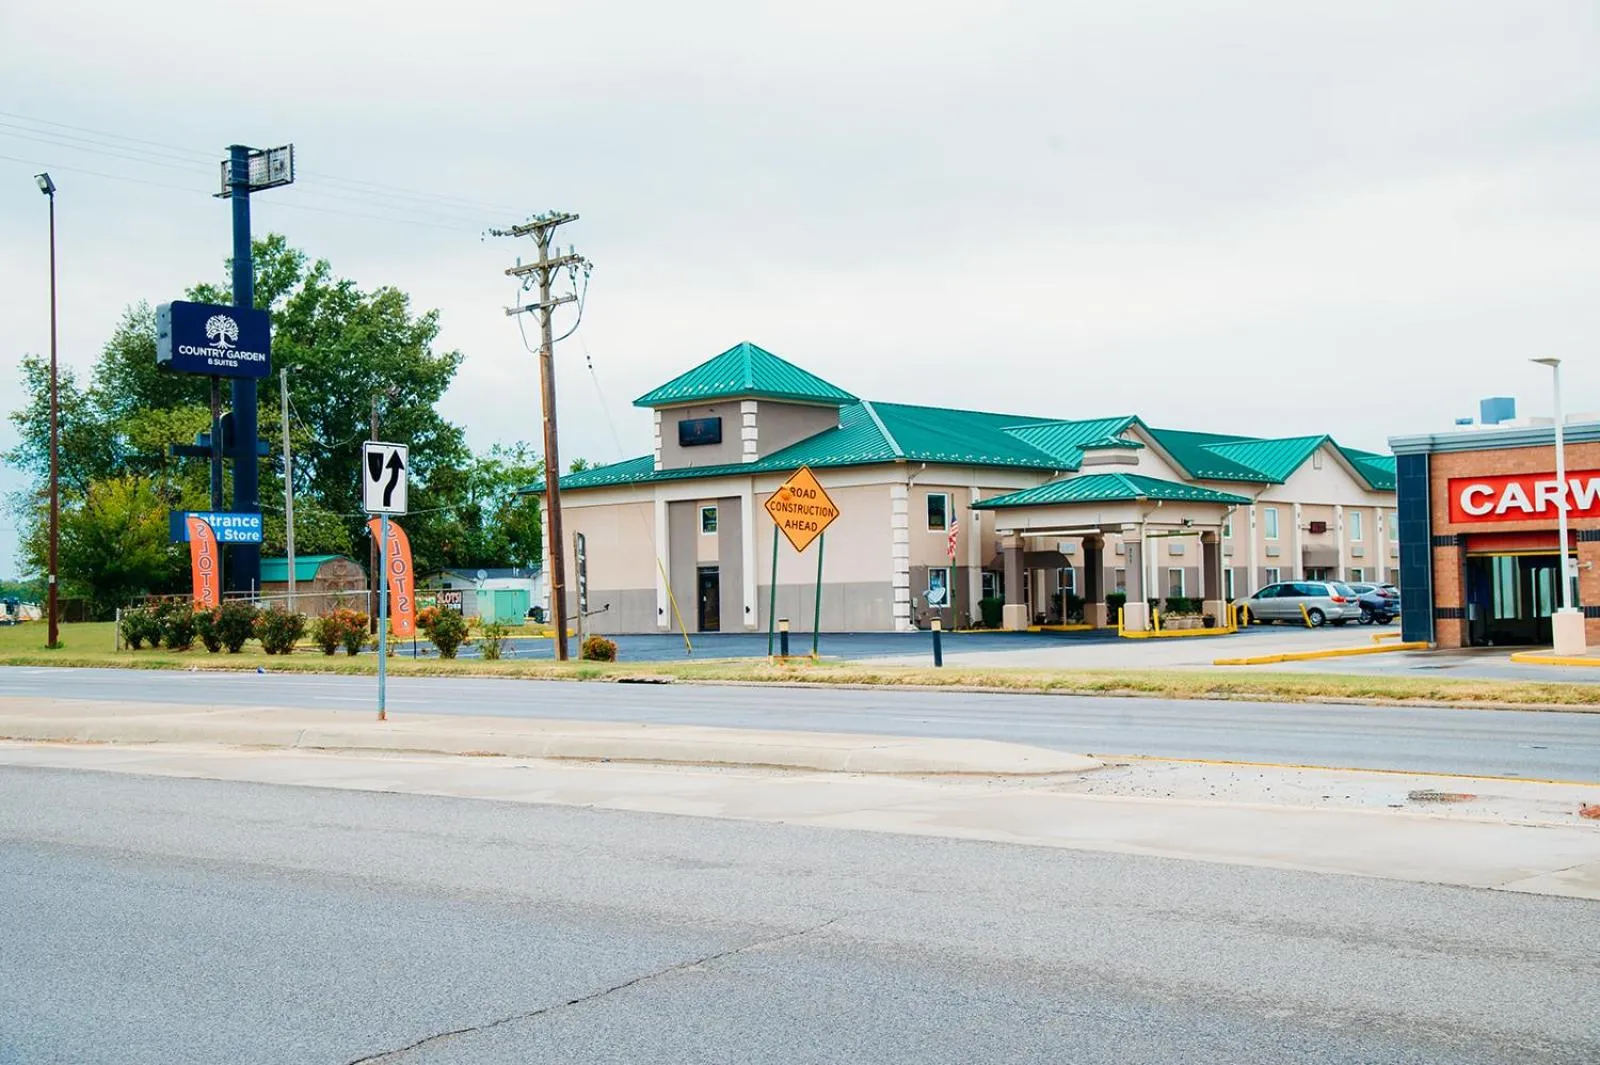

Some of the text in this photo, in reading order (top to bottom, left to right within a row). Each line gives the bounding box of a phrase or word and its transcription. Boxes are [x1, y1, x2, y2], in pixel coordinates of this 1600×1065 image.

[178, 345, 266, 362] COUNTRY GARDEN
[214, 359, 238, 367] SUITES
[790, 487, 817, 500] ROAD
[770, 501, 834, 518] CONSTRUCTION
[784, 519, 818, 532] AHEAD
[224, 529, 260, 541] Store
